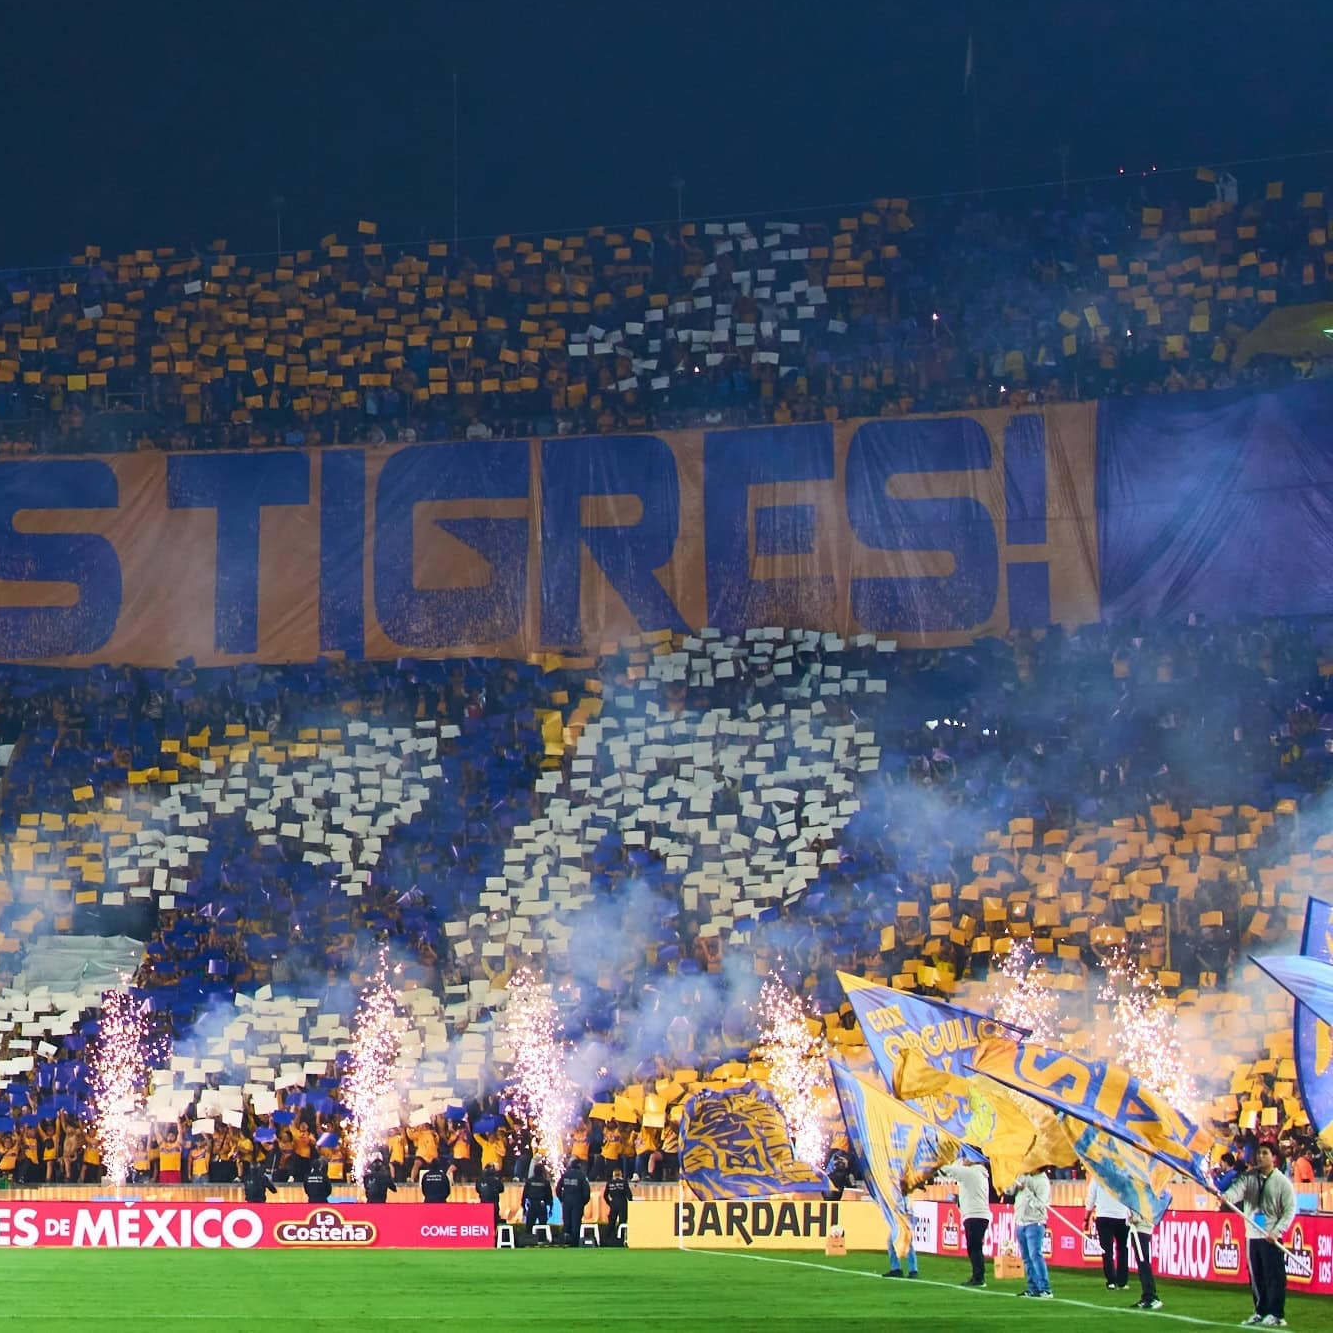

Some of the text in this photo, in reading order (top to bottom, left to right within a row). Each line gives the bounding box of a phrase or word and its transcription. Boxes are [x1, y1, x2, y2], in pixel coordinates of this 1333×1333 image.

[167, 413, 1050, 656] TIGRES!
[45, 1218, 71, 1237] DE
[72, 1201, 264, 1248] MÉXICO
[316, 1212, 335, 1226] La
[282, 1224, 367, 1241] Costeña
[420, 1225, 489, 1237] COME BIEN
[1159, 1212, 1210, 1279] MÉXICO
[1317, 1234, 1332, 1257] SON
[1318, 1261, 1331, 1283] LOS
